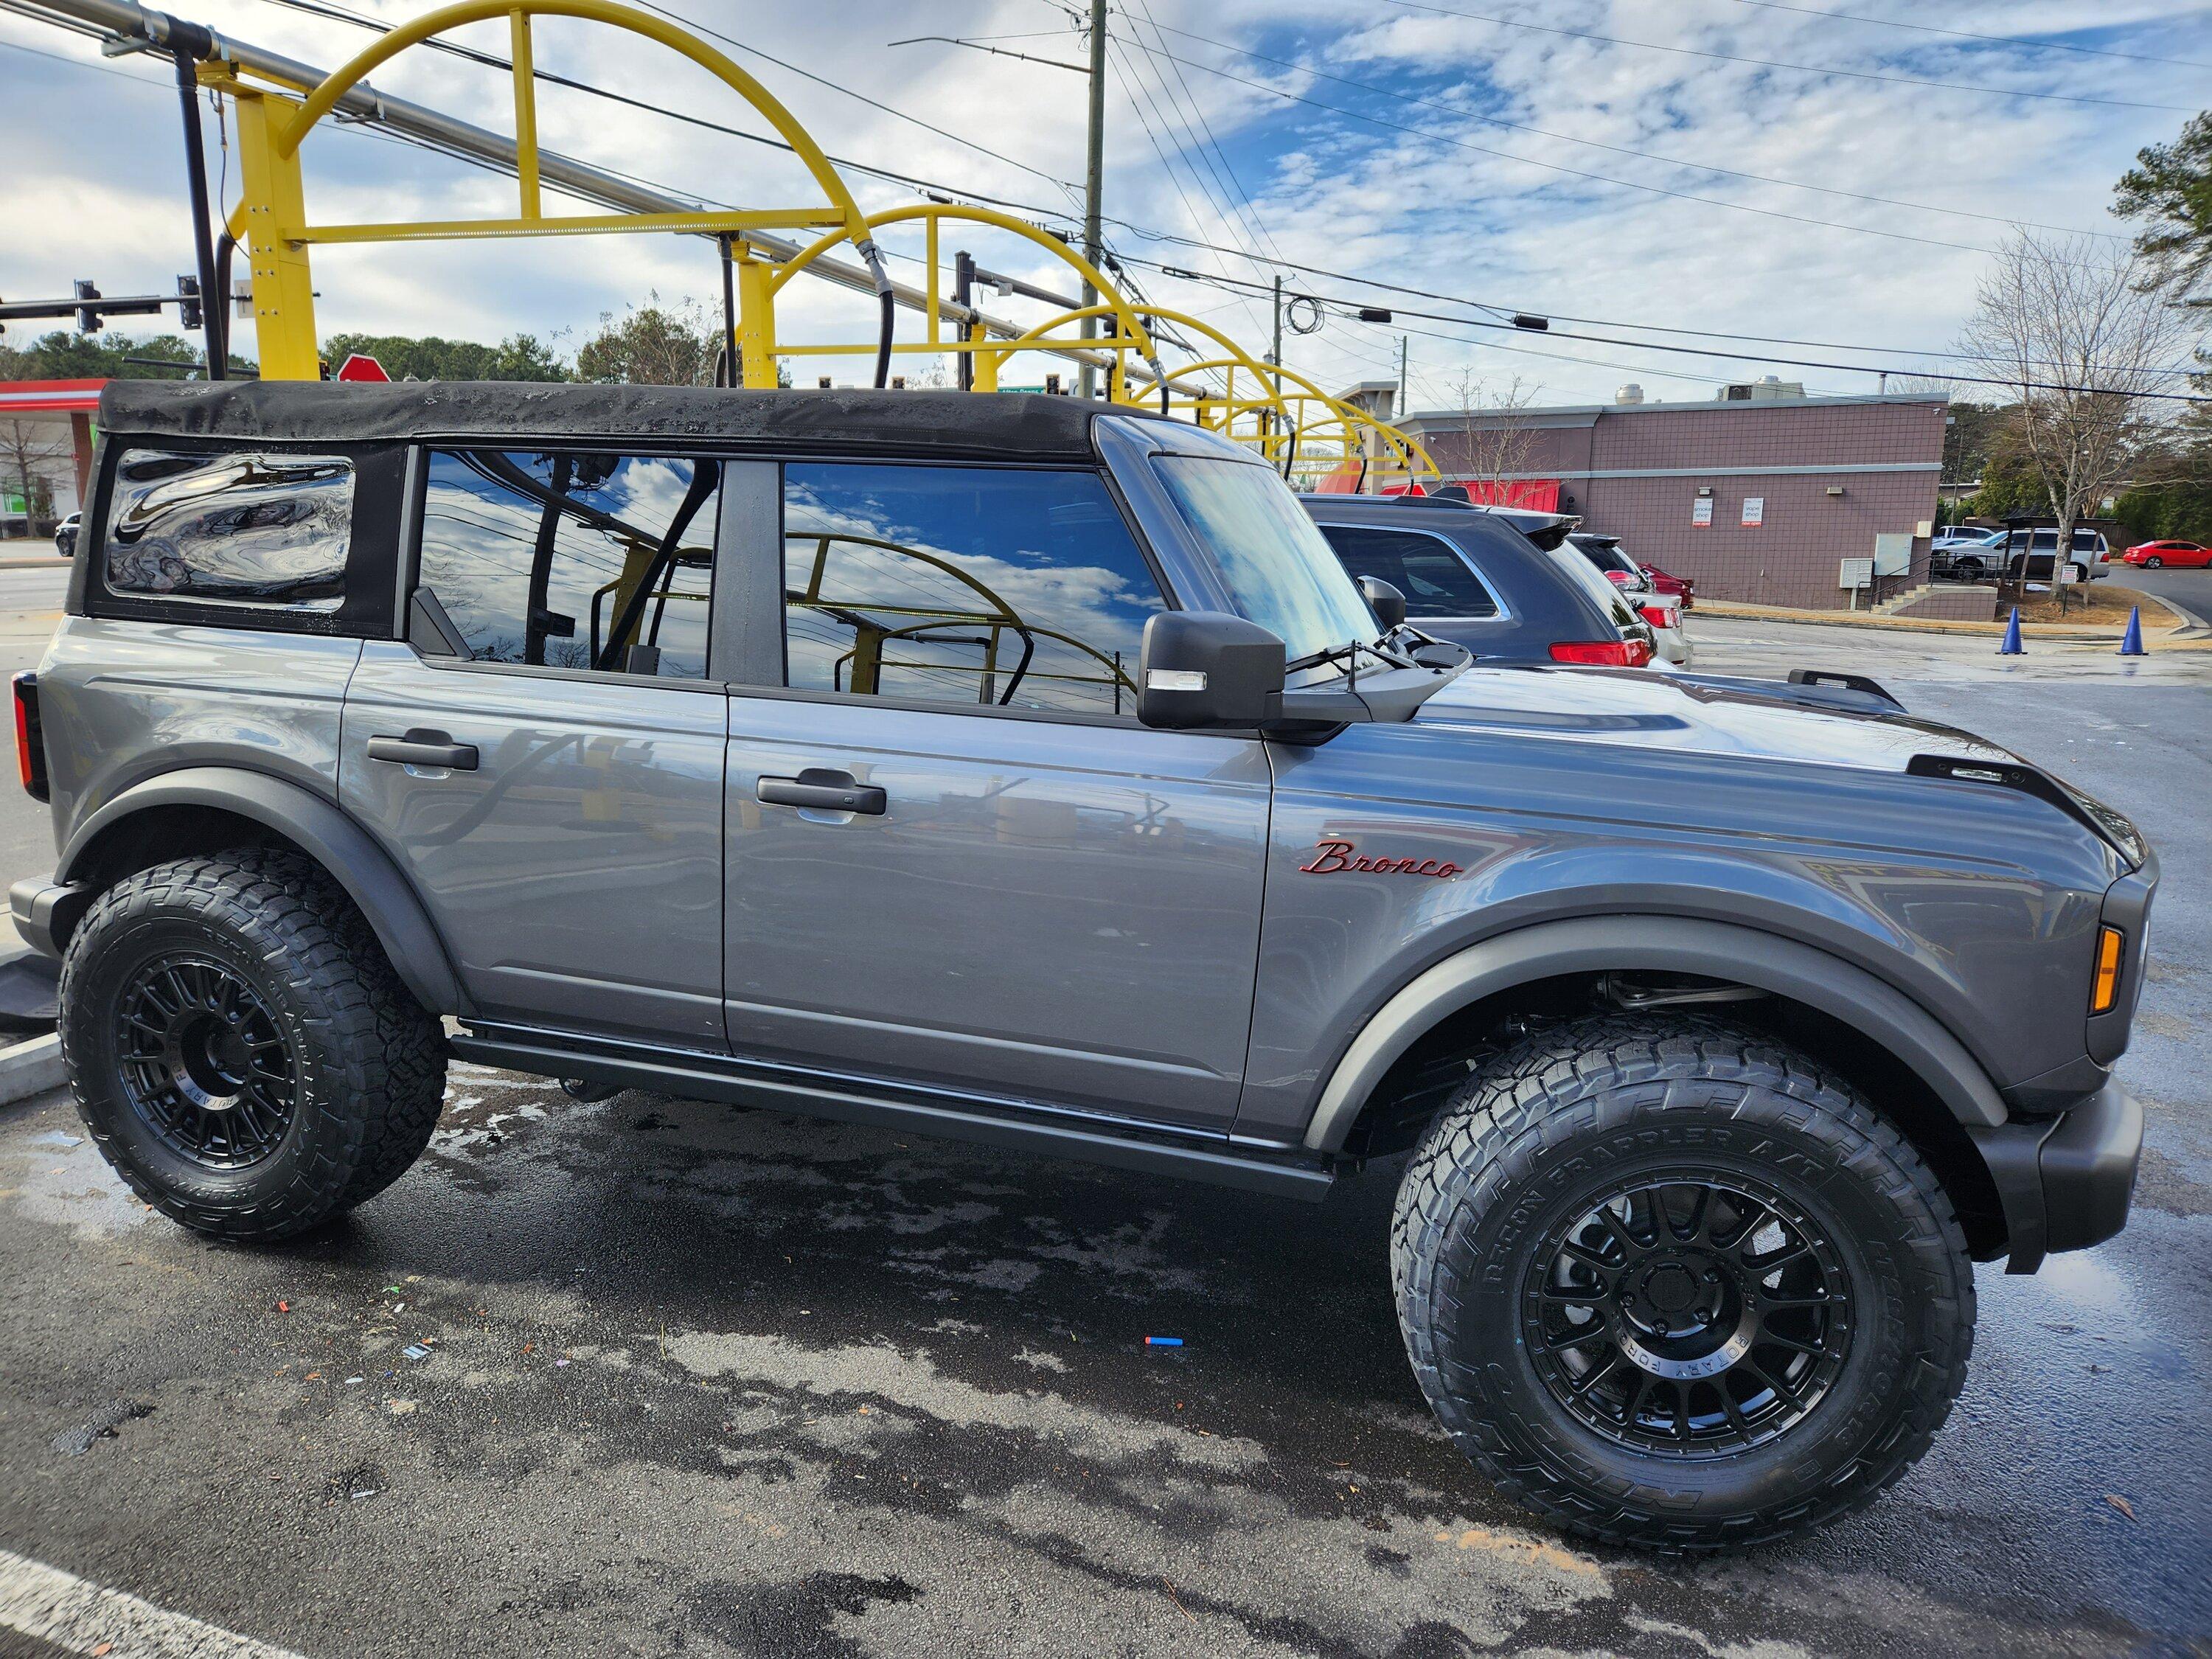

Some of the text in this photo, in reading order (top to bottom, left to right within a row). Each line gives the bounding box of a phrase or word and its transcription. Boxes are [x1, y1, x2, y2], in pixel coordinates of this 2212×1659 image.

[1298, 839, 1464, 879] Bronco
[1484, 1125, 1826, 1284] RECON GRAPPLER A/T
[1674, 1333, 1750, 1377] ROTARY
